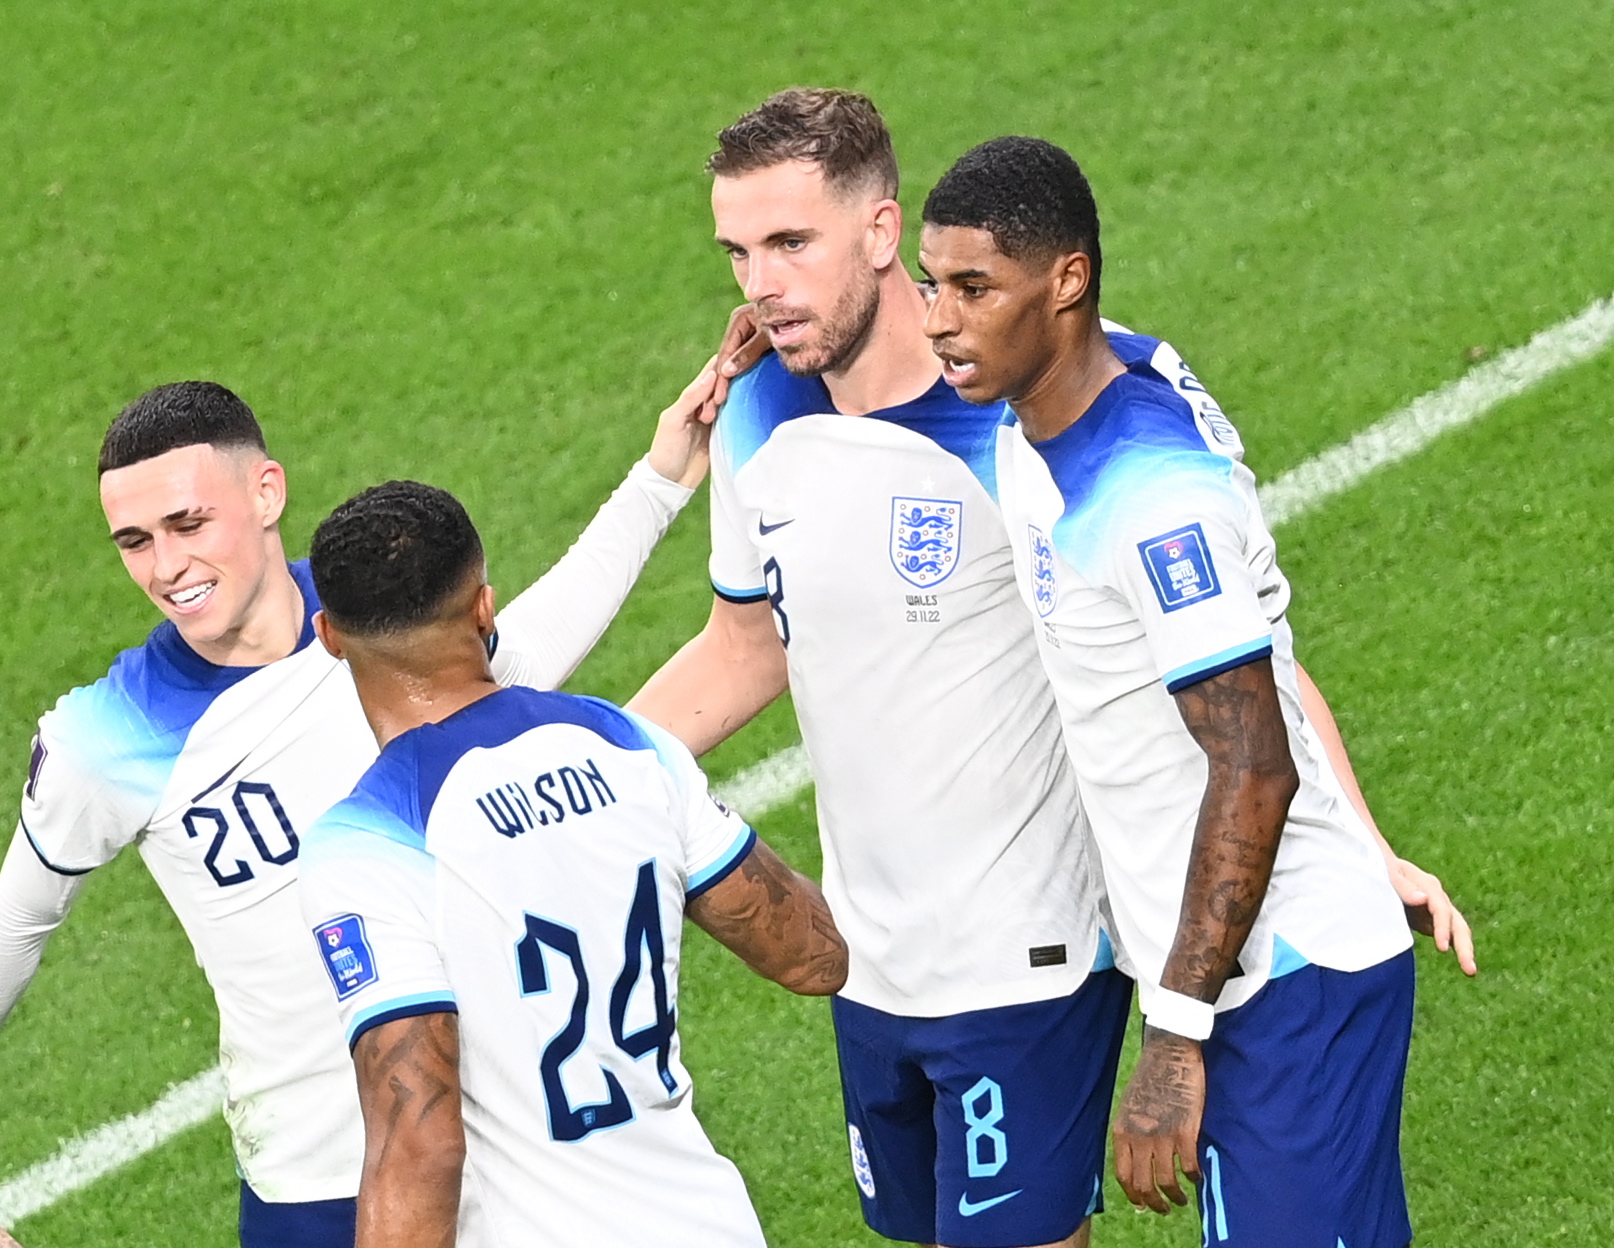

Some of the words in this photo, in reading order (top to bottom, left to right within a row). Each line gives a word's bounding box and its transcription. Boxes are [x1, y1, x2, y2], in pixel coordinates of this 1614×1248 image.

[905, 594, 938, 606] WALES
[906, 609, 941, 623] 29.11.22
[181, 780, 300, 887] 20
[514, 857, 679, 1143] 24
[961, 1076, 1008, 1179] 8
